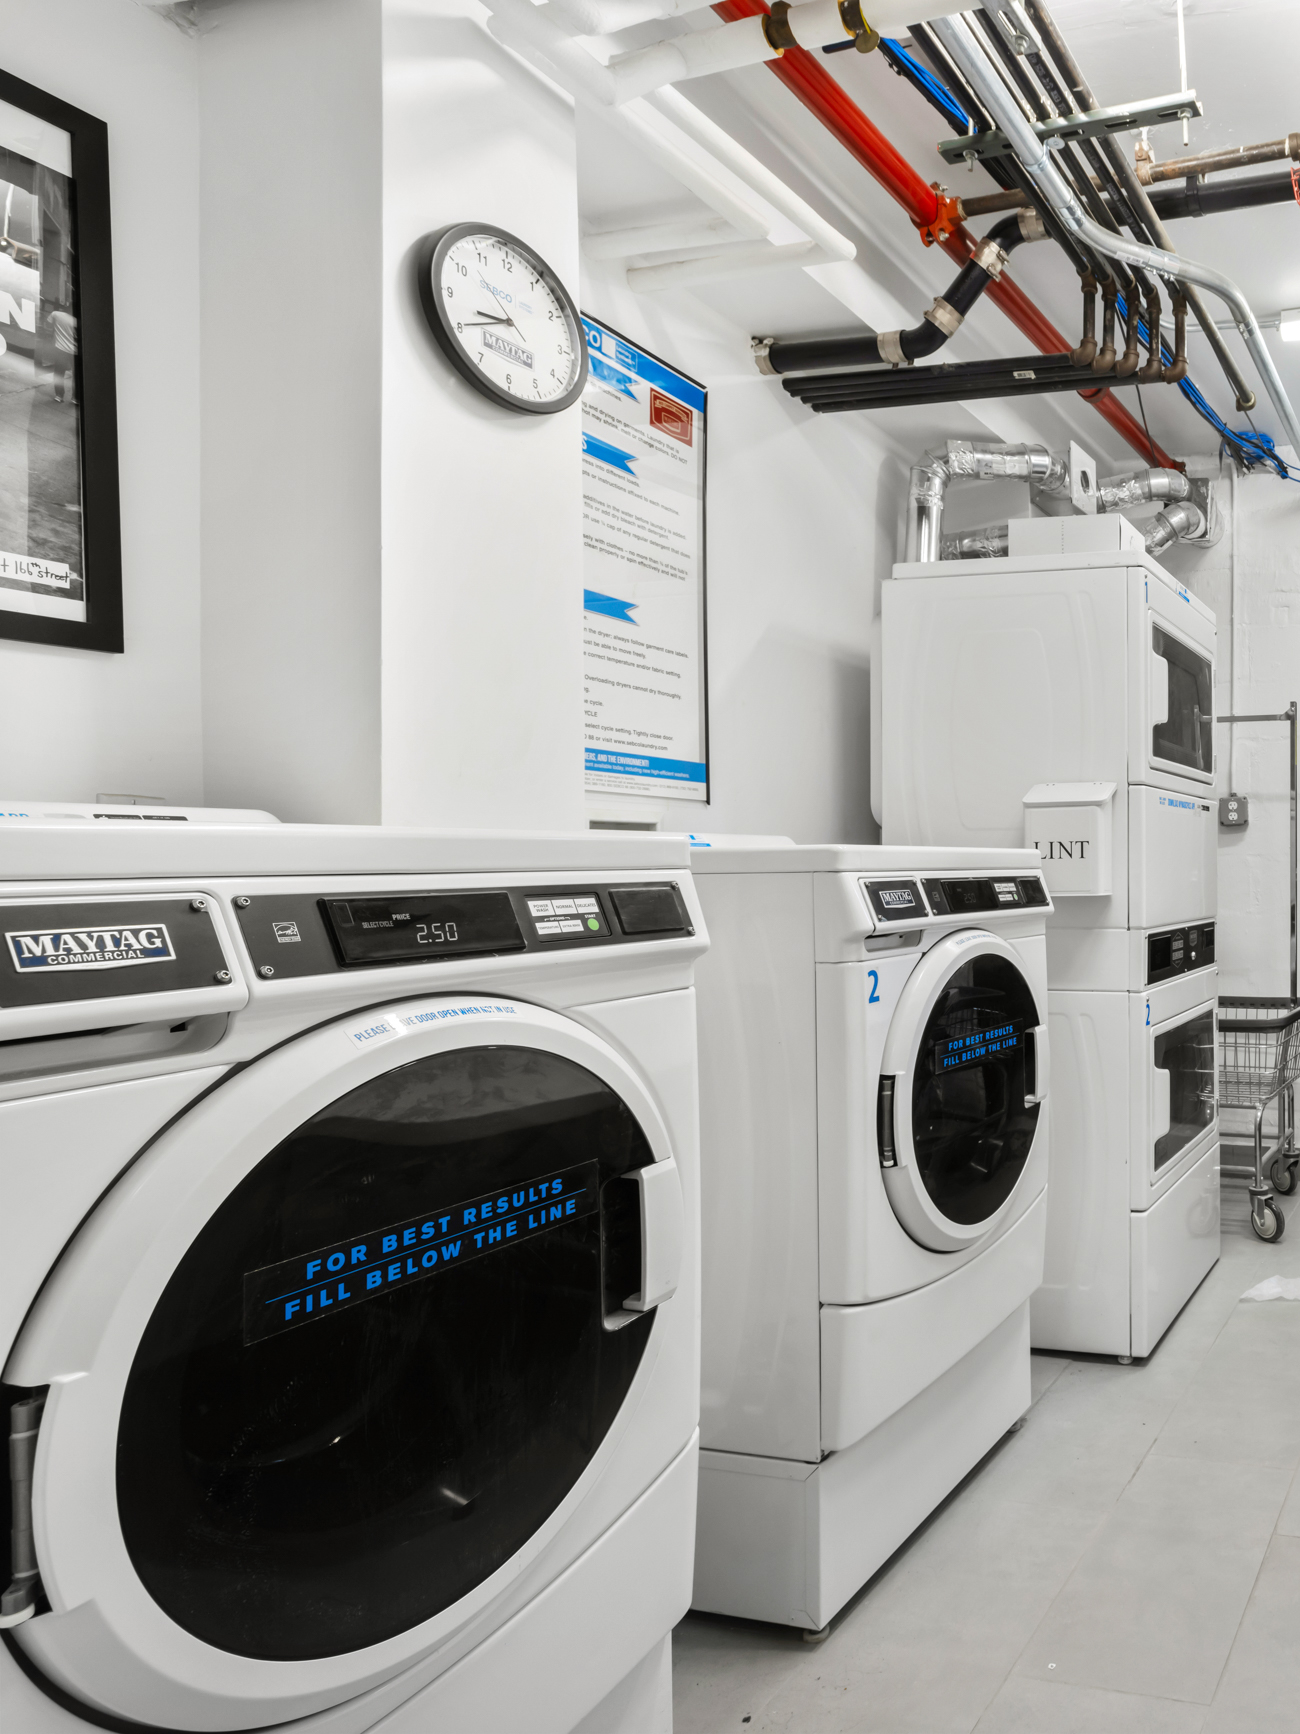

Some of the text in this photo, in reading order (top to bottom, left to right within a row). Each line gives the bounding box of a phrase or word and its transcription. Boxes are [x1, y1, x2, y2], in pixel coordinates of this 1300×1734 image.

[477, 252, 487, 266] 11
[502, 259, 513, 273] 12
[455, 263, 467, 277] 10
[447, 287, 453, 298] 9
[480, 279, 513, 303] SEBCO
[530, 282, 534, 291] 1
[548, 311, 554, 321] 2
[457, 322, 463, 334] 8
[484, 332, 532, 362] MAYTAG
[557, 345, 563, 355] 3
[478, 352, 484, 363] 7
[506, 374, 512, 384] 6
[550, 369, 555, 379] 4
[533, 379, 538, 389] 5
[588, 403, 598, 412] and
[599, 408, 614, 421] drying
[623, 421, 645, 437] garments.
[646, 433, 664, 447] Laundry
[666, 443, 674, 451] that
[591, 413, 602, 423] may
[620, 427, 630, 437] melt
[638, 436, 654, 449] change
[654, 444, 669, 456] colors.
[678, 456, 687, 465] NOT
[595, 463, 640, 487] into different loads.
[597, 476, 626, 492] instructions
[627, 489, 642, 500] affixed
[649, 498, 659, 507] each
[661, 503, 680, 516] machine.
[583, 493, 605, 507] additives
[621, 510, 633, 518] water
[634, 515, 649, 525] before
[650, 521, 666, 533] laundry
[672, 530, 686, 540] added.
[601, 508, 610, 516] add
[611, 513, 619, 521] dry
[620, 516, 635, 527] bleach
[637, 523, 646, 531] with
[647, 527, 669, 541] detergent.
[606, 523, 615, 531] cap
[622, 529, 631, 537] any
[632, 533, 648, 544] regular
[649, 539, 670, 552] detergent
[671, 547, 679, 555] that
[584, 541, 597, 550] clean
[599, 546, 618, 558] properly
[626, 556, 636, 565] spin
[638, 560, 660, 573] effectively
[594, 537, 605, 545] with
[606, 541, 623, 552] clothes
[636, 553, 647, 561] more
[648, 557, 658, 565] than
[37, 567, 69, 583] street
[601, 642, 611, 650] able
[632, 651, 646, 659] freely.
[613, 634, 629, 644] always
[645, 643, 664, 653] garment
[588, 651, 605, 660] correct
[606, 656, 635, 668] temperature
[665, 670, 681, 679] setting.
[585, 674, 614, 686] Overloading
[616, 681, 631, 690] dryers
[632, 684, 648, 692] cannot
[657, 690, 681, 700] thoroughly.
[589, 699, 604, 707] cycle.
[615, 727, 632, 735] setting.
[633, 730, 648, 738] Tightly
[613, 738, 668, 752] www.sebcolaundry.com
[597, 753, 607, 762] AND
[608, 755, 616, 763] THE
[882, 892, 912, 901] MAYTAG
[362, 920, 394, 929] SELECT CYCLE
[392, 913, 411, 921] PRICE
[416, 922, 458, 943] 2.50
[16, 929, 163, 958] MAYTAG
[47, 950, 145, 965] COMMERCIAL
[868, 970, 880, 1004] 2
[353, 1024, 390, 1042] PLEASE
[415, 1012, 439, 1023] DOOR
[437, 1009, 460, 1019] OPEN
[457, 1006, 482, 1016] WHEN
[502, 1006, 517, 1014] USE
[1146, 1004, 1150, 1026] 2
[948, 1025, 1013, 1051] FOR BEST RESULTS
[943, 1037, 1017, 1067] FILL BELOW THE LINE
[306, 1178, 563, 1280] FOR BEST RESULTS
[284, 1199, 577, 1321] FILL BELOW THE LINE
